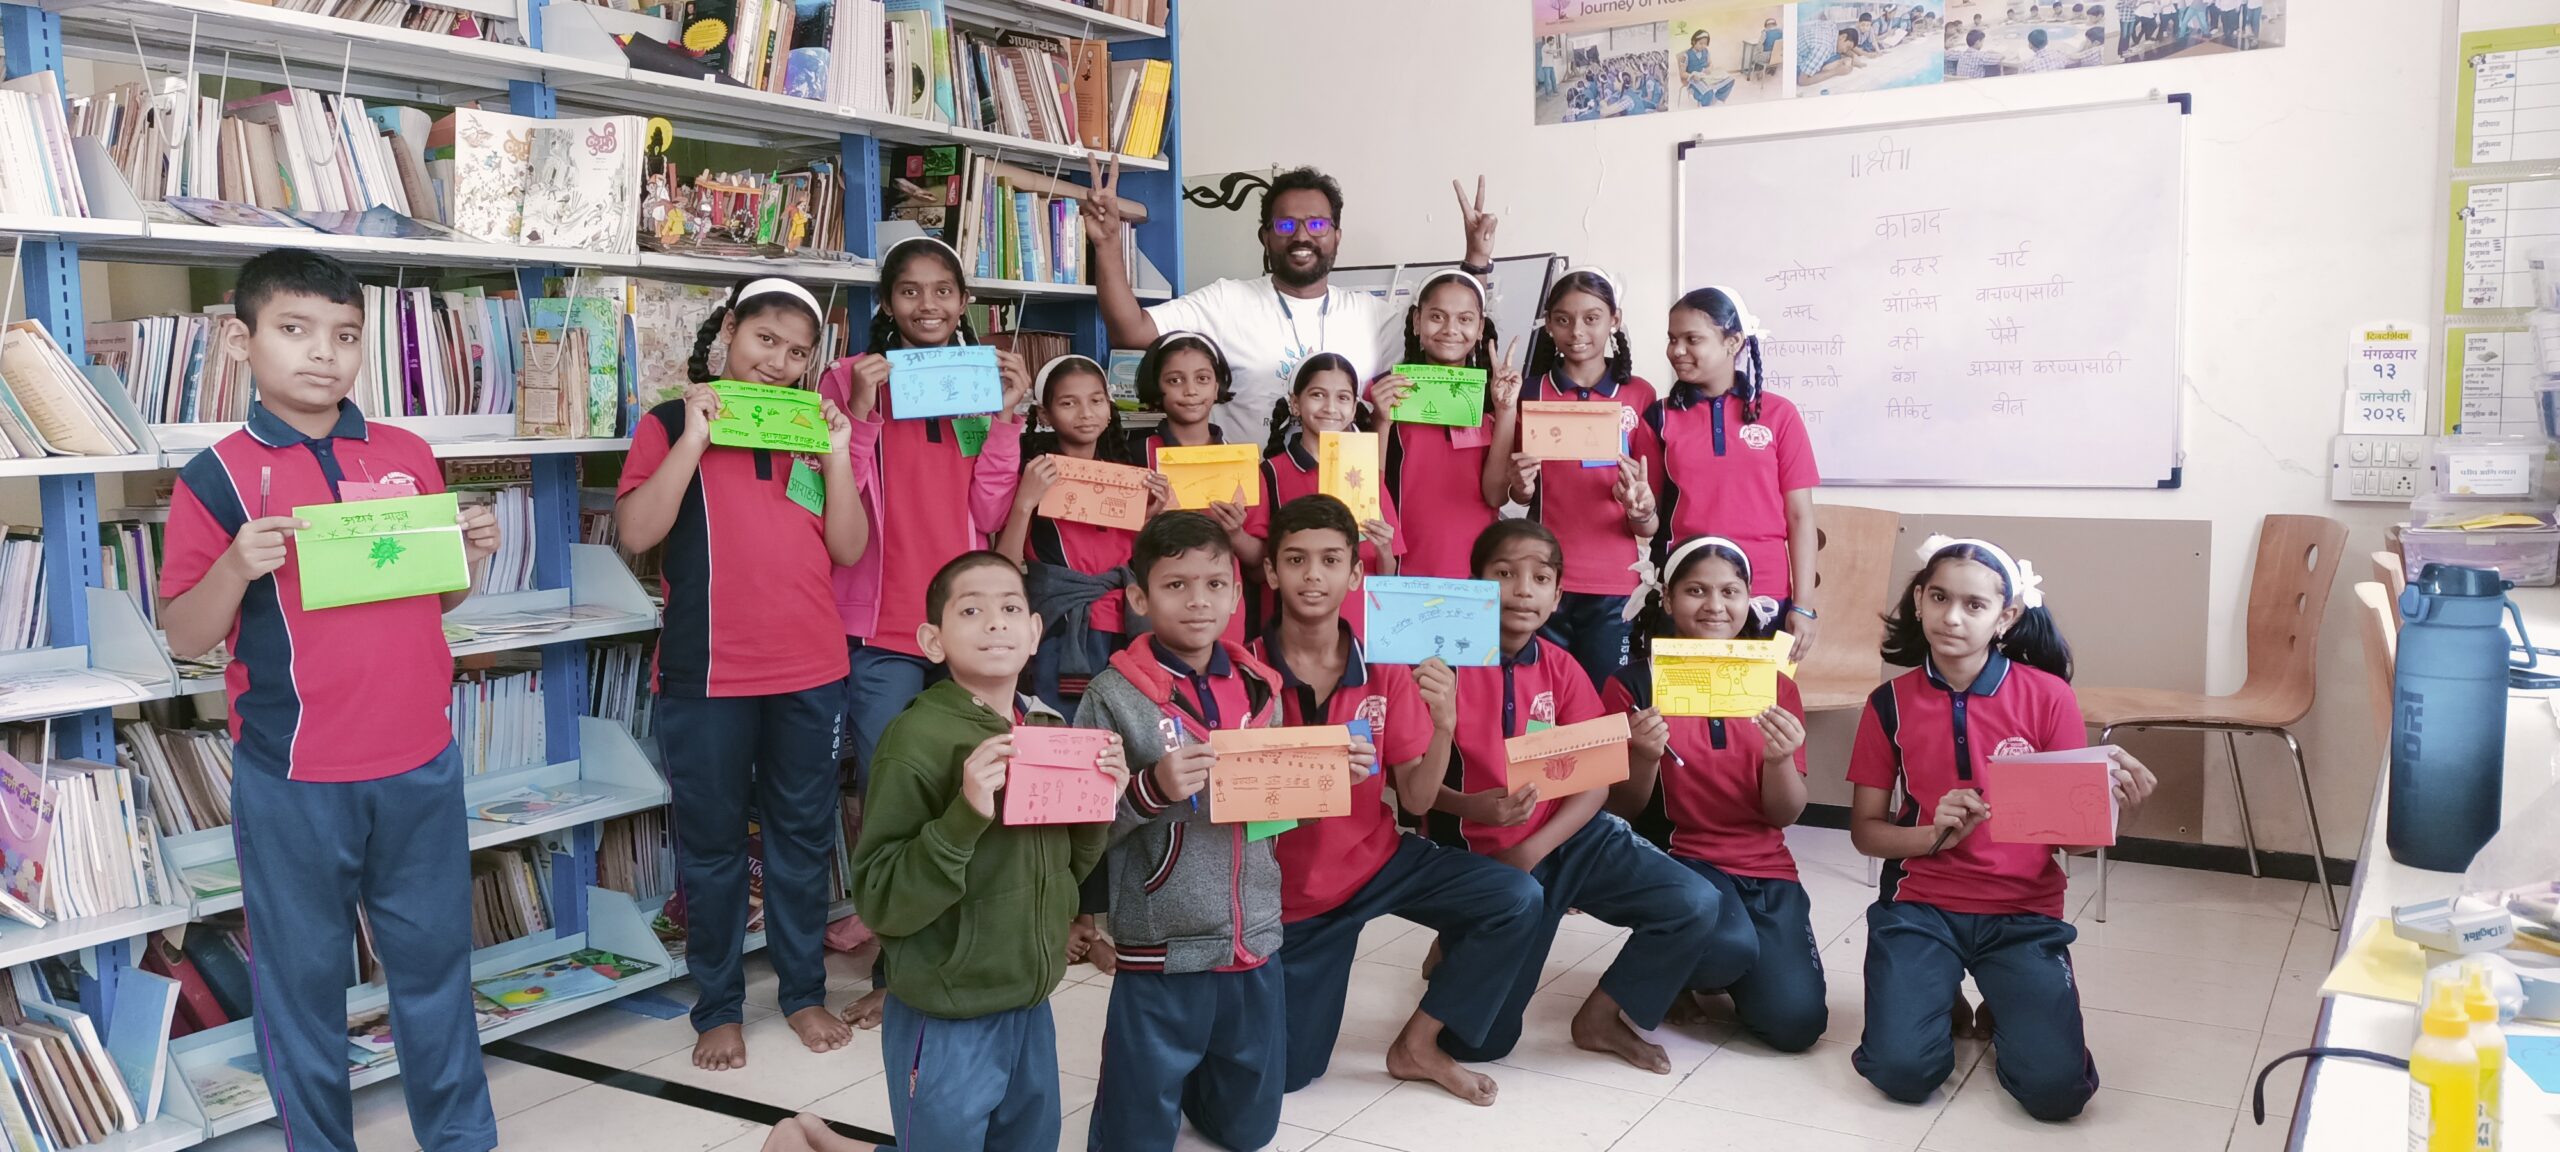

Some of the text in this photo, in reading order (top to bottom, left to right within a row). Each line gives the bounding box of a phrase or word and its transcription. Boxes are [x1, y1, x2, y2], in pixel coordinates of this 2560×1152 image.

[1580, 0, 1634, 16] Journey
[1008, 34, 1059, 53] गणकयंत्र
[1875, 208, 1951, 240] कागद
[2362, 345, 2418, 360] मंगळवार
[2373, 363, 2396, 380] १३
[2359, 389, 2412, 403] जानेवारी
[2363, 407, 2406, 422] २०२६
